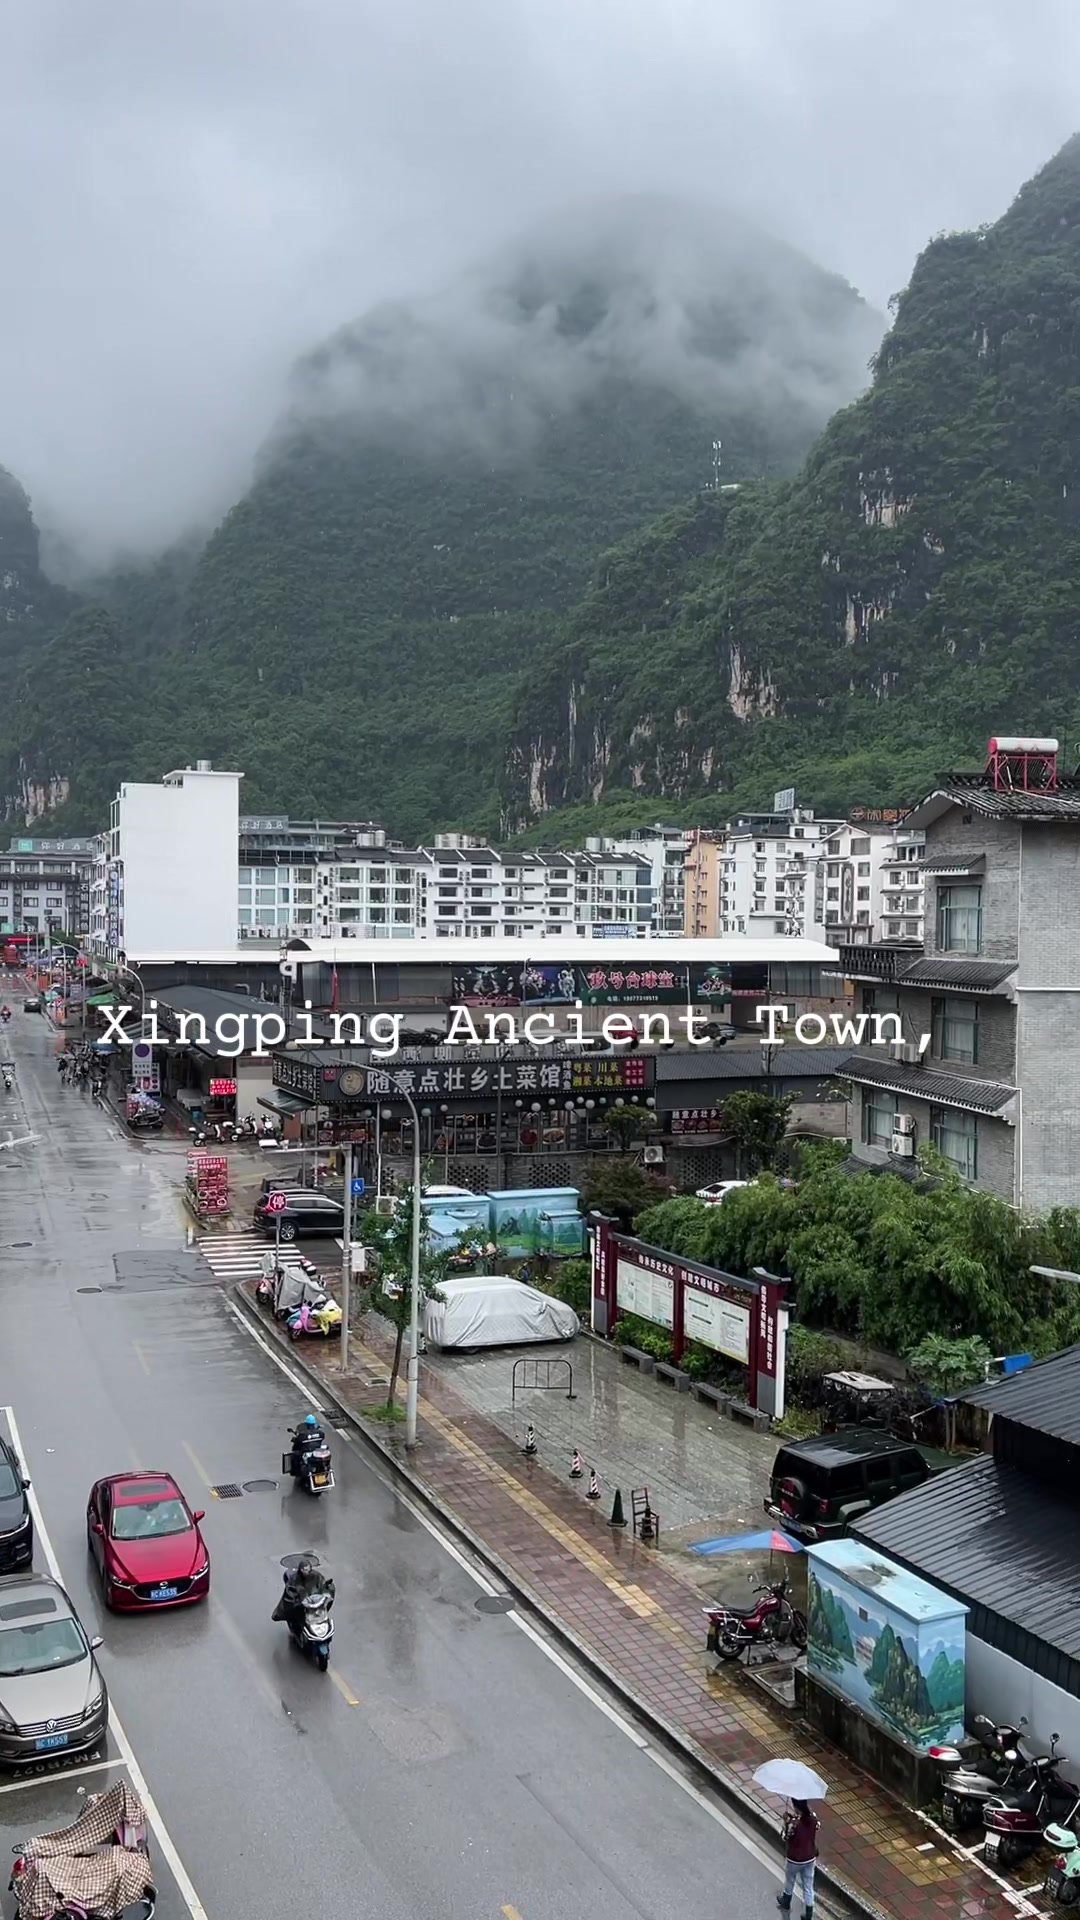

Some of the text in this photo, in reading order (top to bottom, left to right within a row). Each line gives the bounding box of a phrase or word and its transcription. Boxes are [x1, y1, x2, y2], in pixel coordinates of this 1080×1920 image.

[597, 1062, 619, 1073] 川菜
[366, 1063, 561, 1095] 随意点壮乡土菜馆
[272, 1195, 285, 1208] 停
